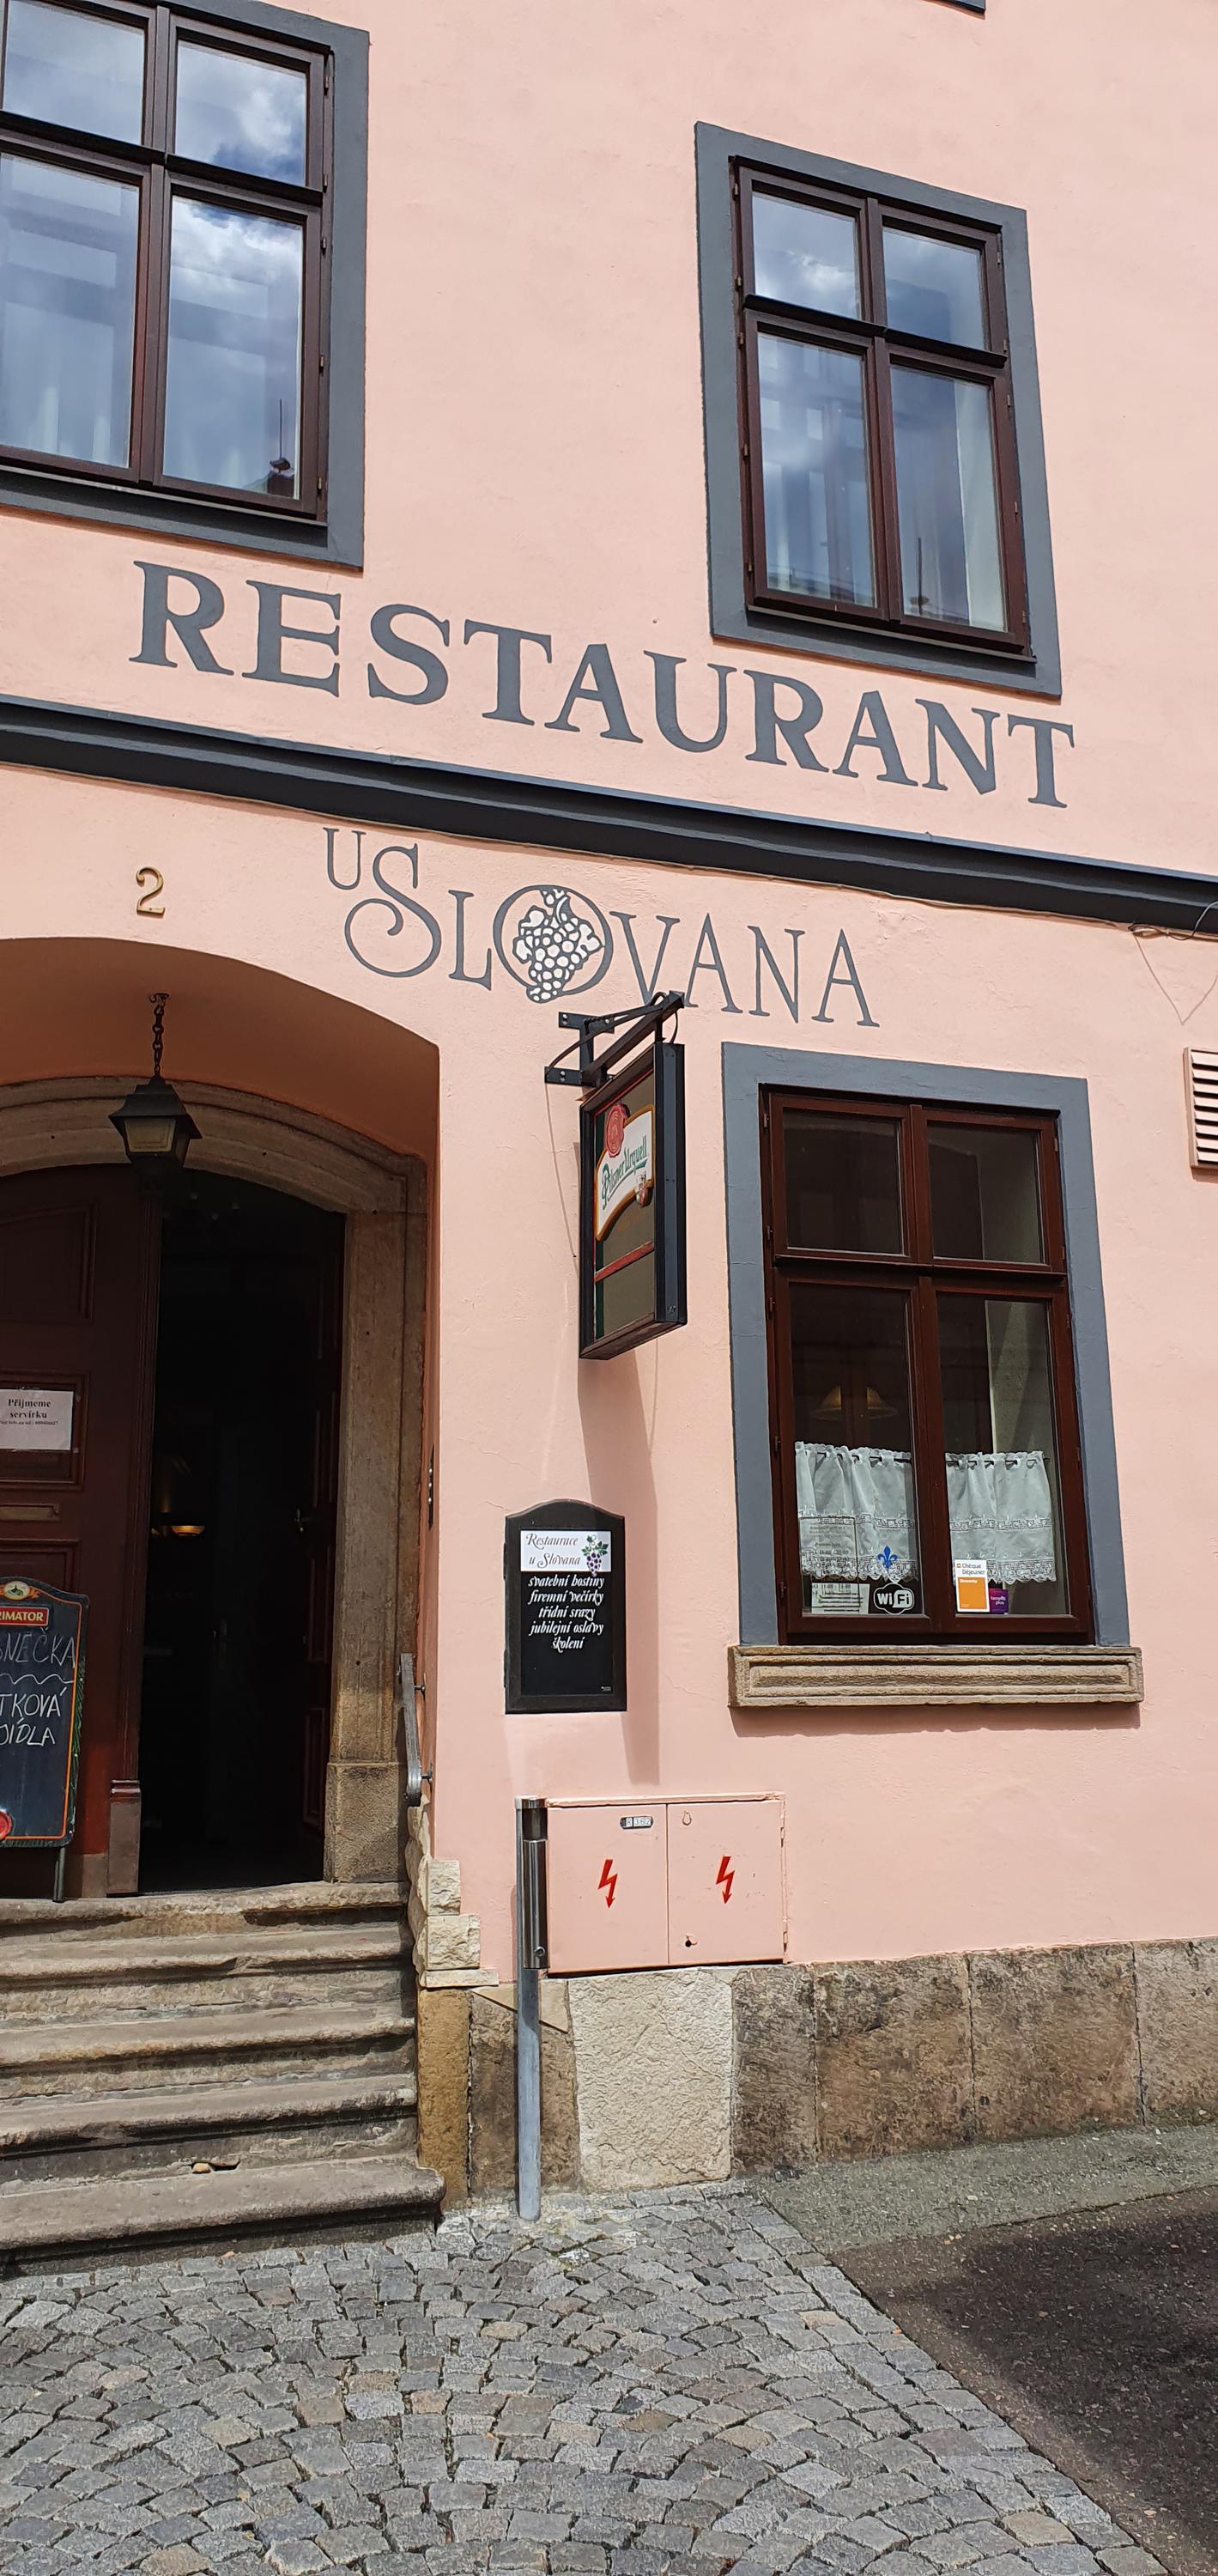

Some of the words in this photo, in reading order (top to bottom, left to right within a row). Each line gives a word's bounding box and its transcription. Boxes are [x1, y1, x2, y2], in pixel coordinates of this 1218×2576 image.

[129, 561, 1075, 808] RESTAURANT
[323, 827, 367, 890] U
[136, 866, 166, 919] 2
[344, 842, 880, 1028] SLOVANA
[9, 1410, 47, 1419] servírku
[525, 1533, 579, 1550] Restaurace
[529, 1556, 536, 1565] u
[536, 1552, 581, 1569] Slovana
[528, 1574, 571, 1587] svatební
[527, 1589, 568, 1605] firemní
[568, 1589, 604, 1607] večírky
[877, 1593, 910, 1605] WiFi
[538, 1605, 569, 1619] třídní
[569, 1608, 596, 1621] srazy
[528, 1620, 573, 1637] jubilejní
[573, 1620, 604, 1636] oslavy
[0, 1627, 76, 1668] NEČKA
[552, 1636, 585, 1653] školení
